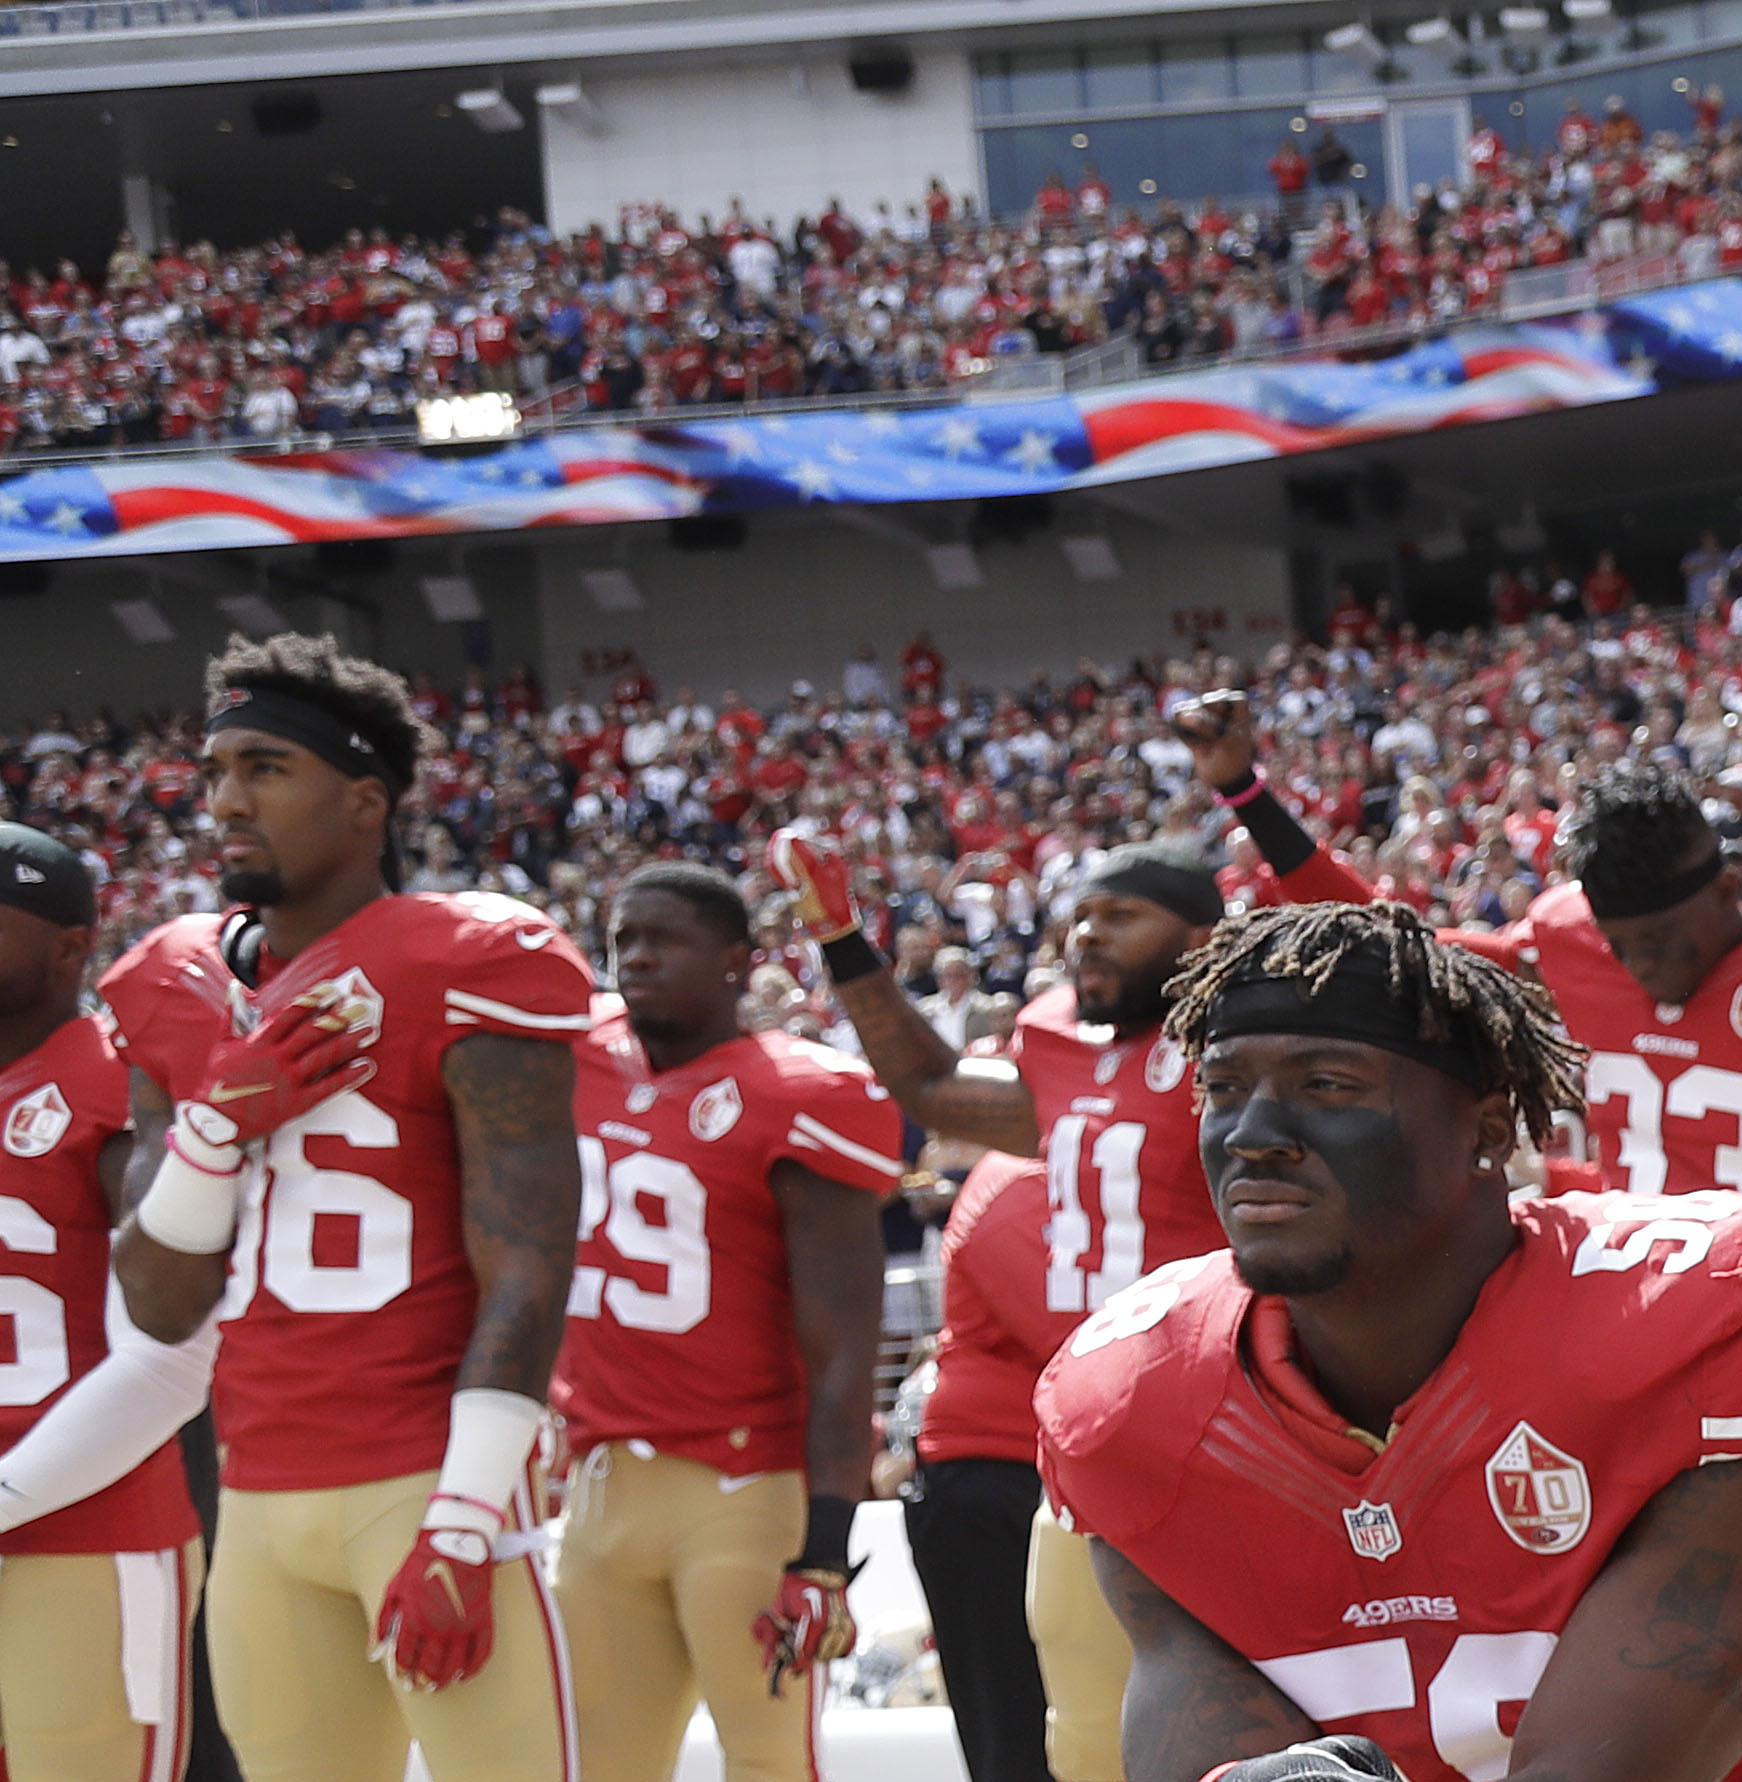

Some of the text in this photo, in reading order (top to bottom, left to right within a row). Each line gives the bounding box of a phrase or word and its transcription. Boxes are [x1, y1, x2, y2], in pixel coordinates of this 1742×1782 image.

[1045, 1113, 1148, 1313] 41
[1503, 1474, 1570, 1514] 70
[1356, 1524, 1394, 1551] NFL
[1341, 1595, 1460, 1629] 49ERS
